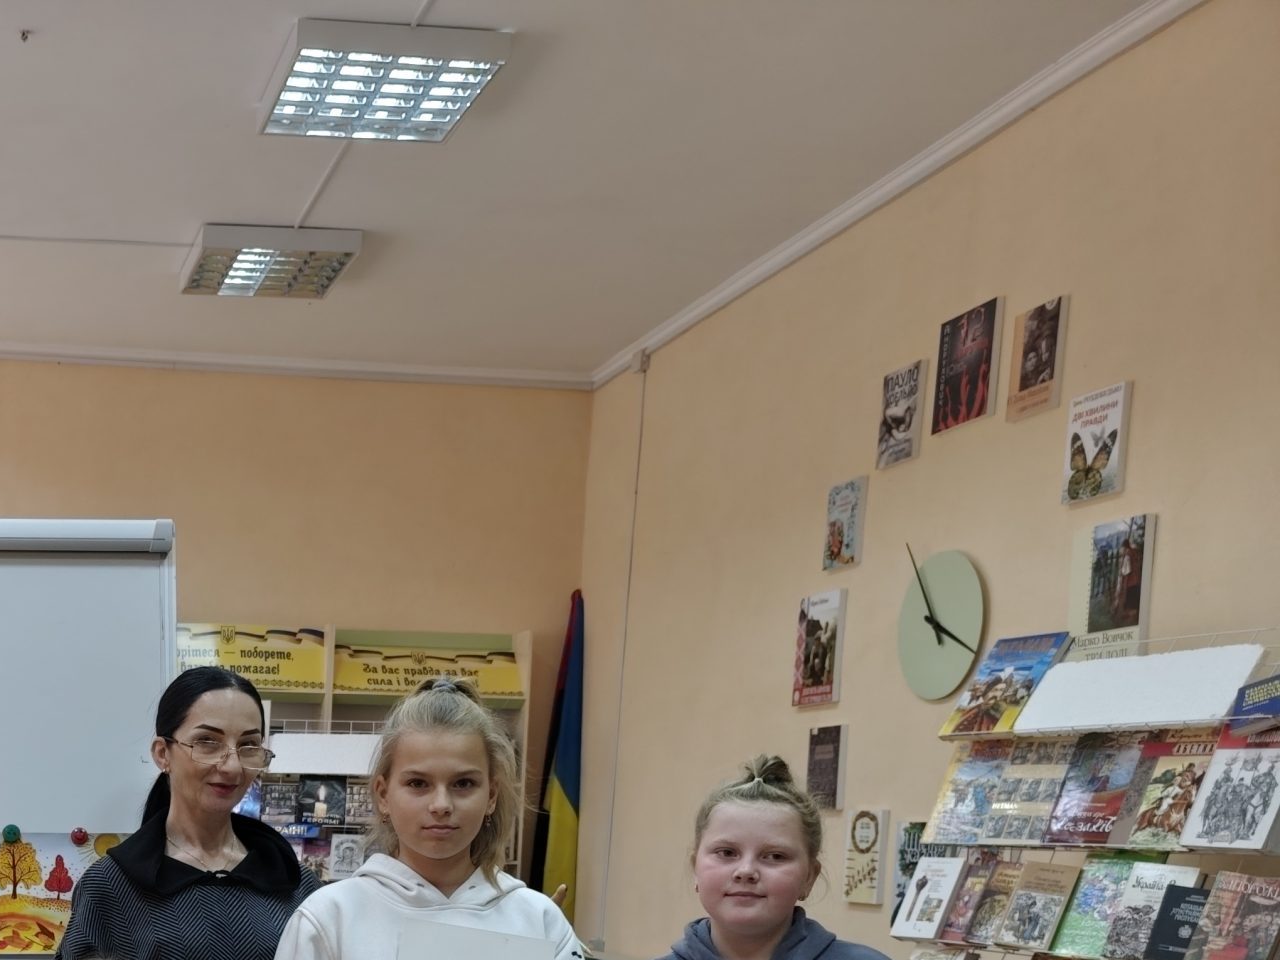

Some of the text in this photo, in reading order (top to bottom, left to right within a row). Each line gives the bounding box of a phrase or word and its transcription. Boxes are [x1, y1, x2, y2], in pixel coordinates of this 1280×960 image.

[240, 646, 294, 661] поборете,
[230, 664, 280, 676] помагає!
[363, 663, 378, 673] За
[381, 665, 400, 674] вас
[404, 666, 440, 677] правда
[460, 668, 479, 677] вас
[367, 678, 393, 686] сила
[276, 824, 308, 835] РАЇНІ!
